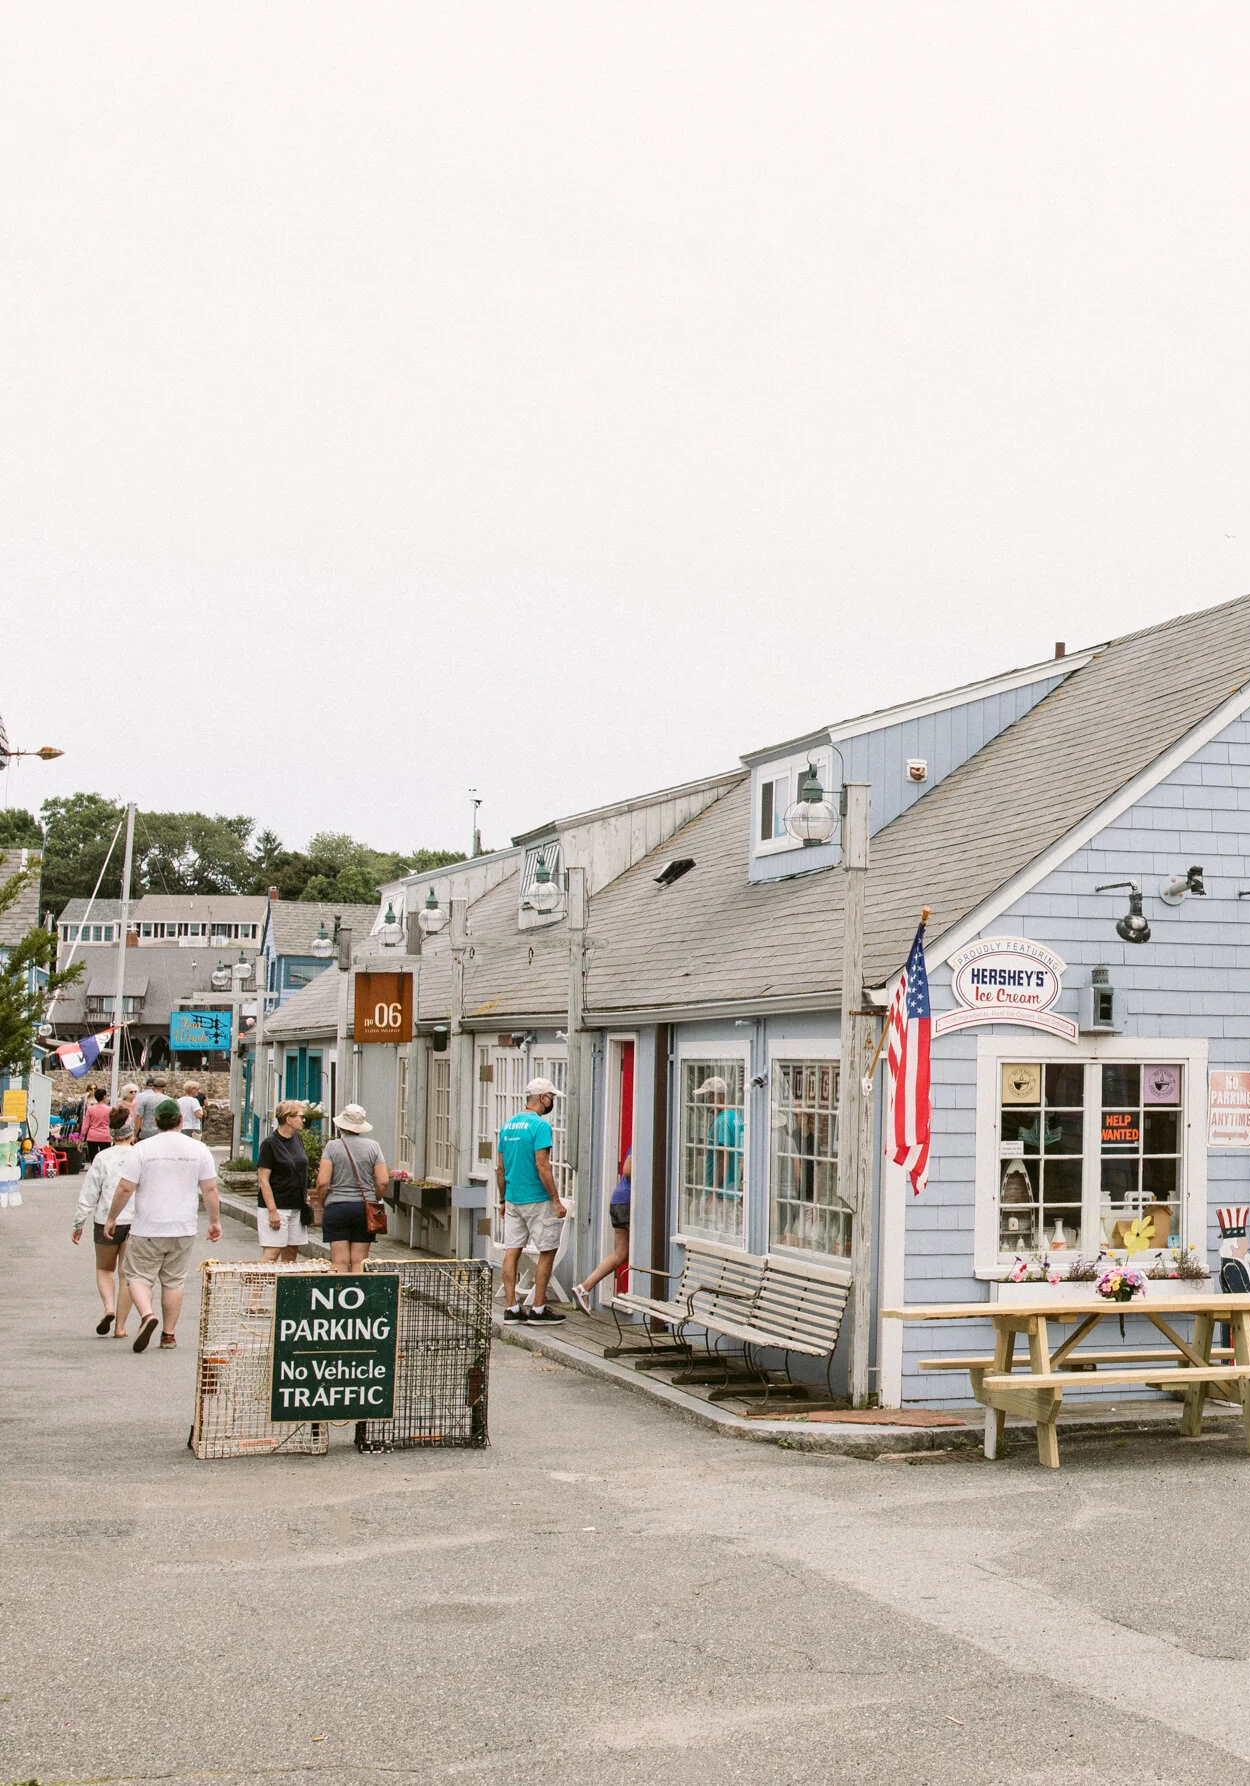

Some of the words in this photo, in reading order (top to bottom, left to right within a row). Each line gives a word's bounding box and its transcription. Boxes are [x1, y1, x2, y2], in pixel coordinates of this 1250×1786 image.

[957, 942, 1001, 965] PROUDLY
[1006, 941, 1059, 971] FEATURING
[971, 968, 1046, 987] HERSHEY'S
[975, 986, 993, 1002] Ice
[996, 988, 1041, 1004] Cream
[375, 1002, 402, 1028] 06
[1225, 1075, 1239, 1090] NO
[1106, 1114, 1132, 1127] HELP
[1211, 1112, 1250, 1127] ANYTIME
[1101, 1128, 1139, 1141] WANTED
[310, 1287, 365, 1310] NO
[279, 1317, 391, 1342] PARKING
[280, 1360, 308, 1381] No
[311, 1359, 386, 1380] Vehicle
[279, 1386, 384, 1408] TRAFFIC
